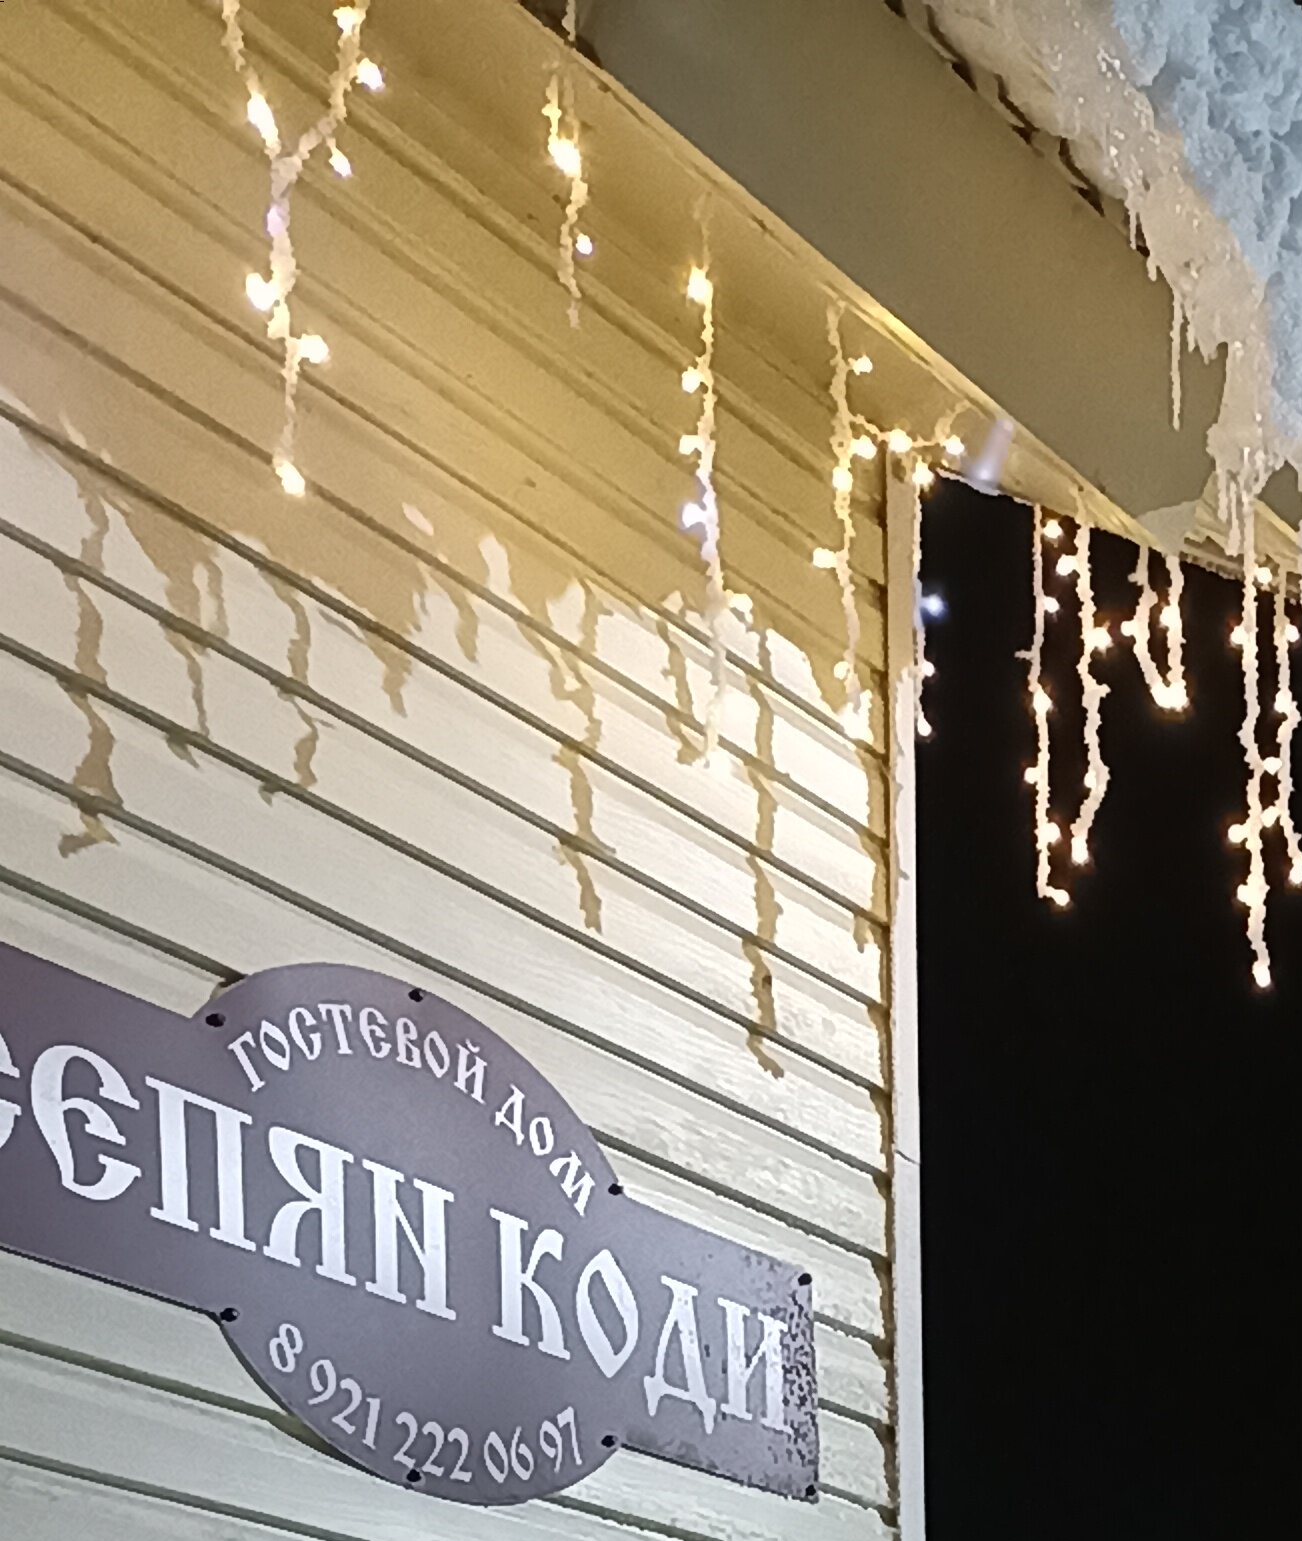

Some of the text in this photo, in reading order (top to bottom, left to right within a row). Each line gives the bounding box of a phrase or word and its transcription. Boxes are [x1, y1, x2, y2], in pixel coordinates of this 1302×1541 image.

[228, 1002, 596, 1217] ГОСТЕВОЙ ДОМ
[0, 1033, 792, 1435] ЕПЯН КОДИ
[269, 1323, 303, 1373] 8
[308, 1359, 380, 1450] 921
[393, 1412, 473, 1483] 222
